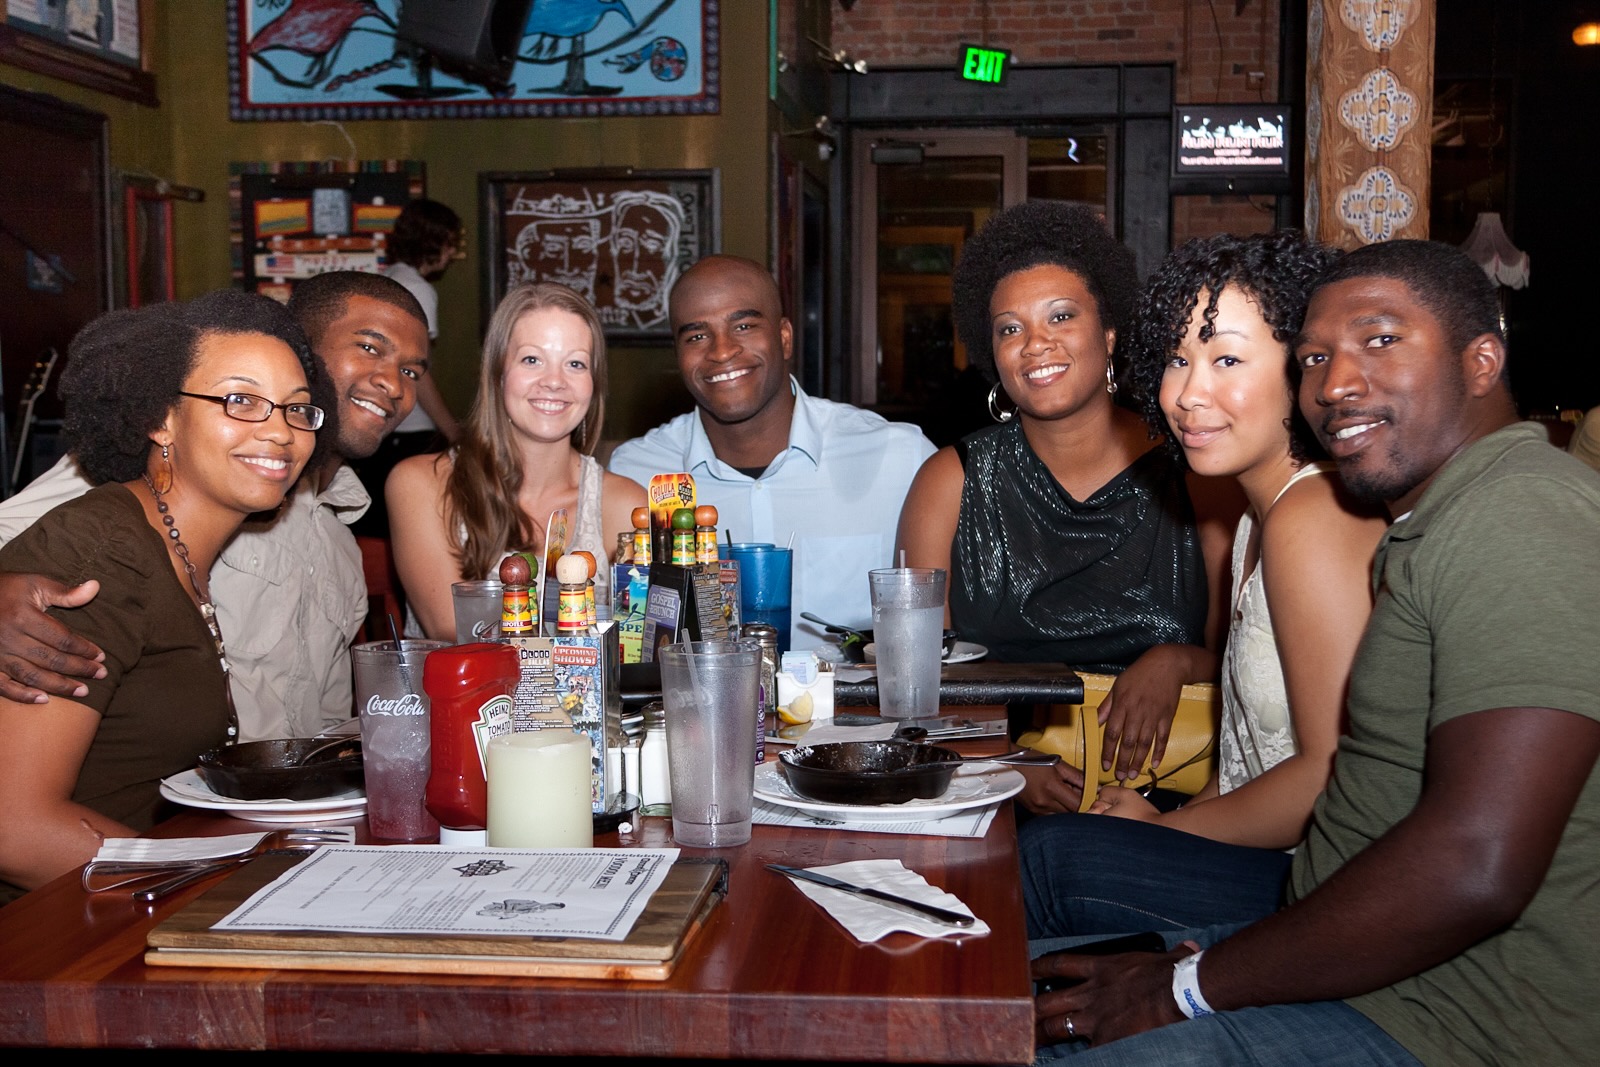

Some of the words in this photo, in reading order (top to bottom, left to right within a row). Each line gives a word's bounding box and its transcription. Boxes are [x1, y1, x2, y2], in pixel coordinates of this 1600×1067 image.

[963, 47, 1007, 83] EXIT
[650, 482, 675, 503] CHOLULA
[651, 592, 676, 609] GOSPEL
[649, 603, 676, 619] BRUNCH
[554, 648, 597, 656] UPCOMING
[554, 655, 596, 664] SHOWS!
[366, 693, 426, 717] Coca-Cola
[489, 704, 509, 719] HEINZ
[488, 720, 511, 736] TOMATO
